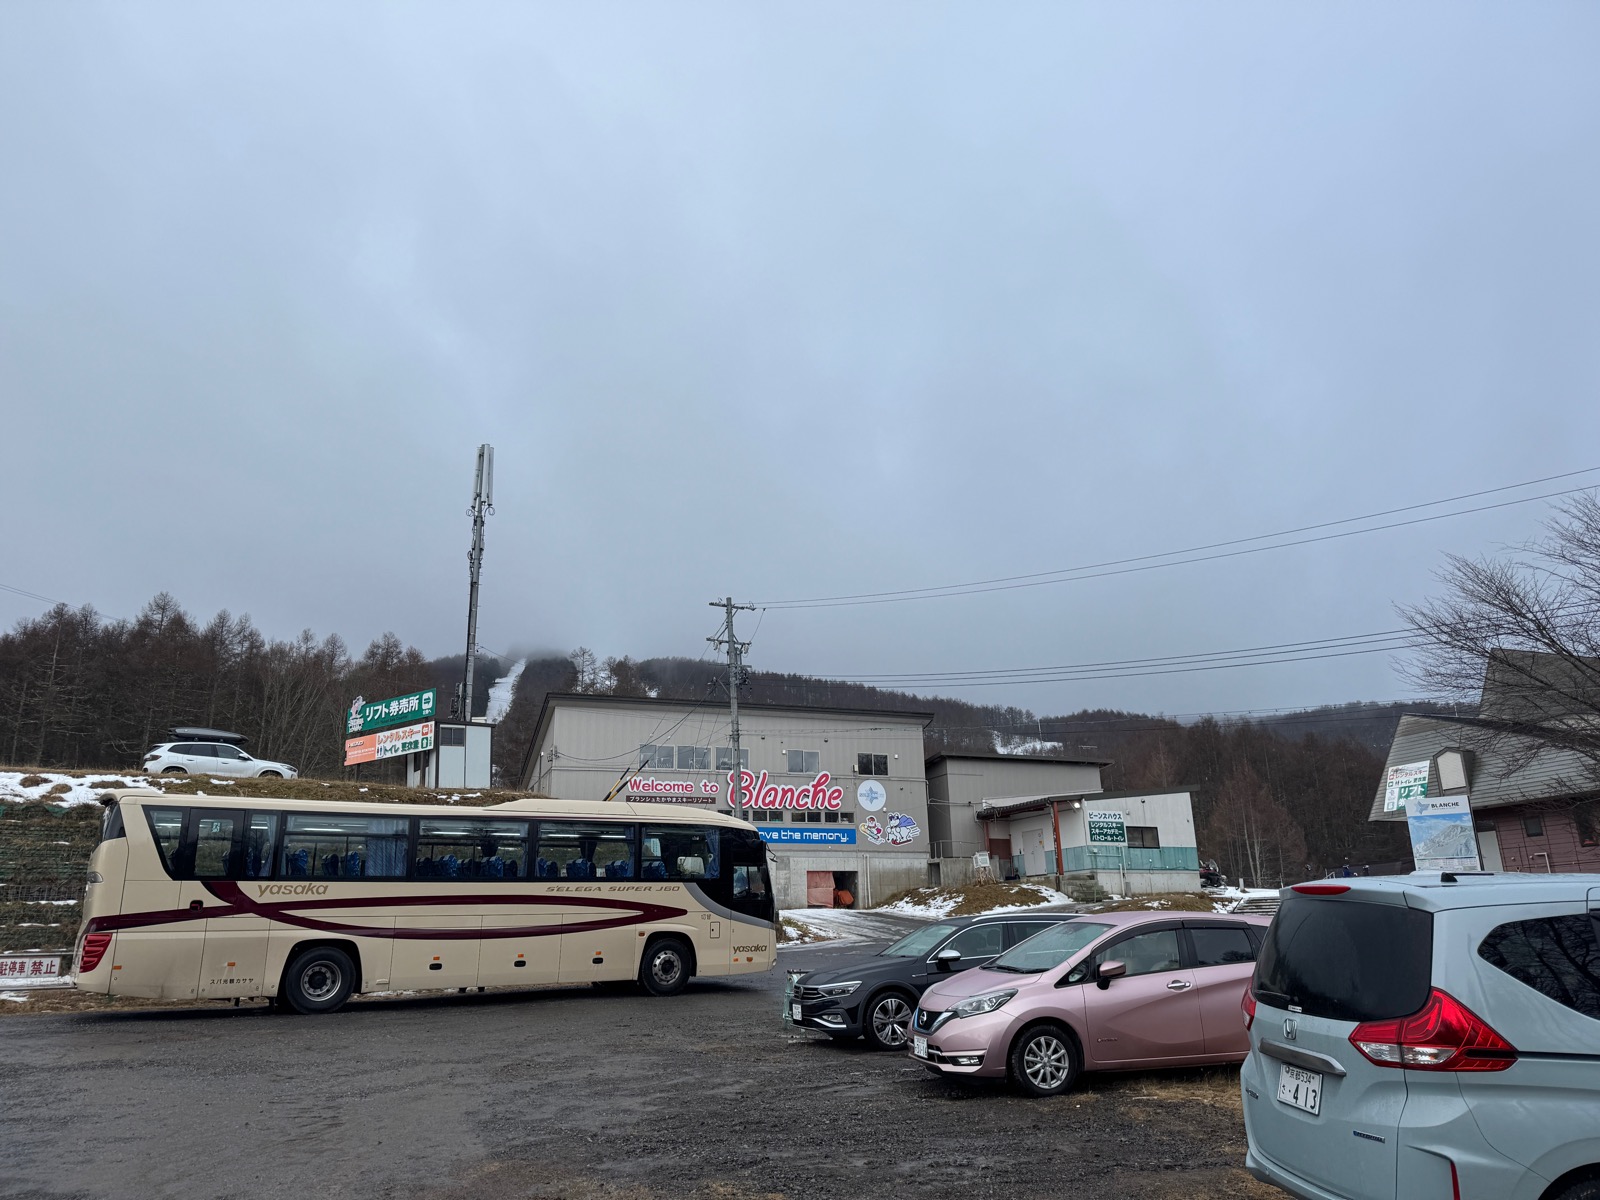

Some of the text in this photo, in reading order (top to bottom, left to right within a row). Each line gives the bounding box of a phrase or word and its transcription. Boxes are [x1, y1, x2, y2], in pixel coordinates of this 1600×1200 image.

[365, 695, 420, 722] リフト券売所
[377, 728, 420, 745] レンタルスキー
[384, 744, 399, 757] トイレ
[628, 778, 694, 793] Welcome
[701, 780, 719, 793] to
[728, 769, 843, 810] Blanche
[1401, 785, 1425, 797] リフト
[759, 829, 849, 843] rve the memory.
[257, 883, 329, 898] yasaka
[733, 944, 768, 954] yasaka
[0, 960, 56, 976] 駐停車 禁止
